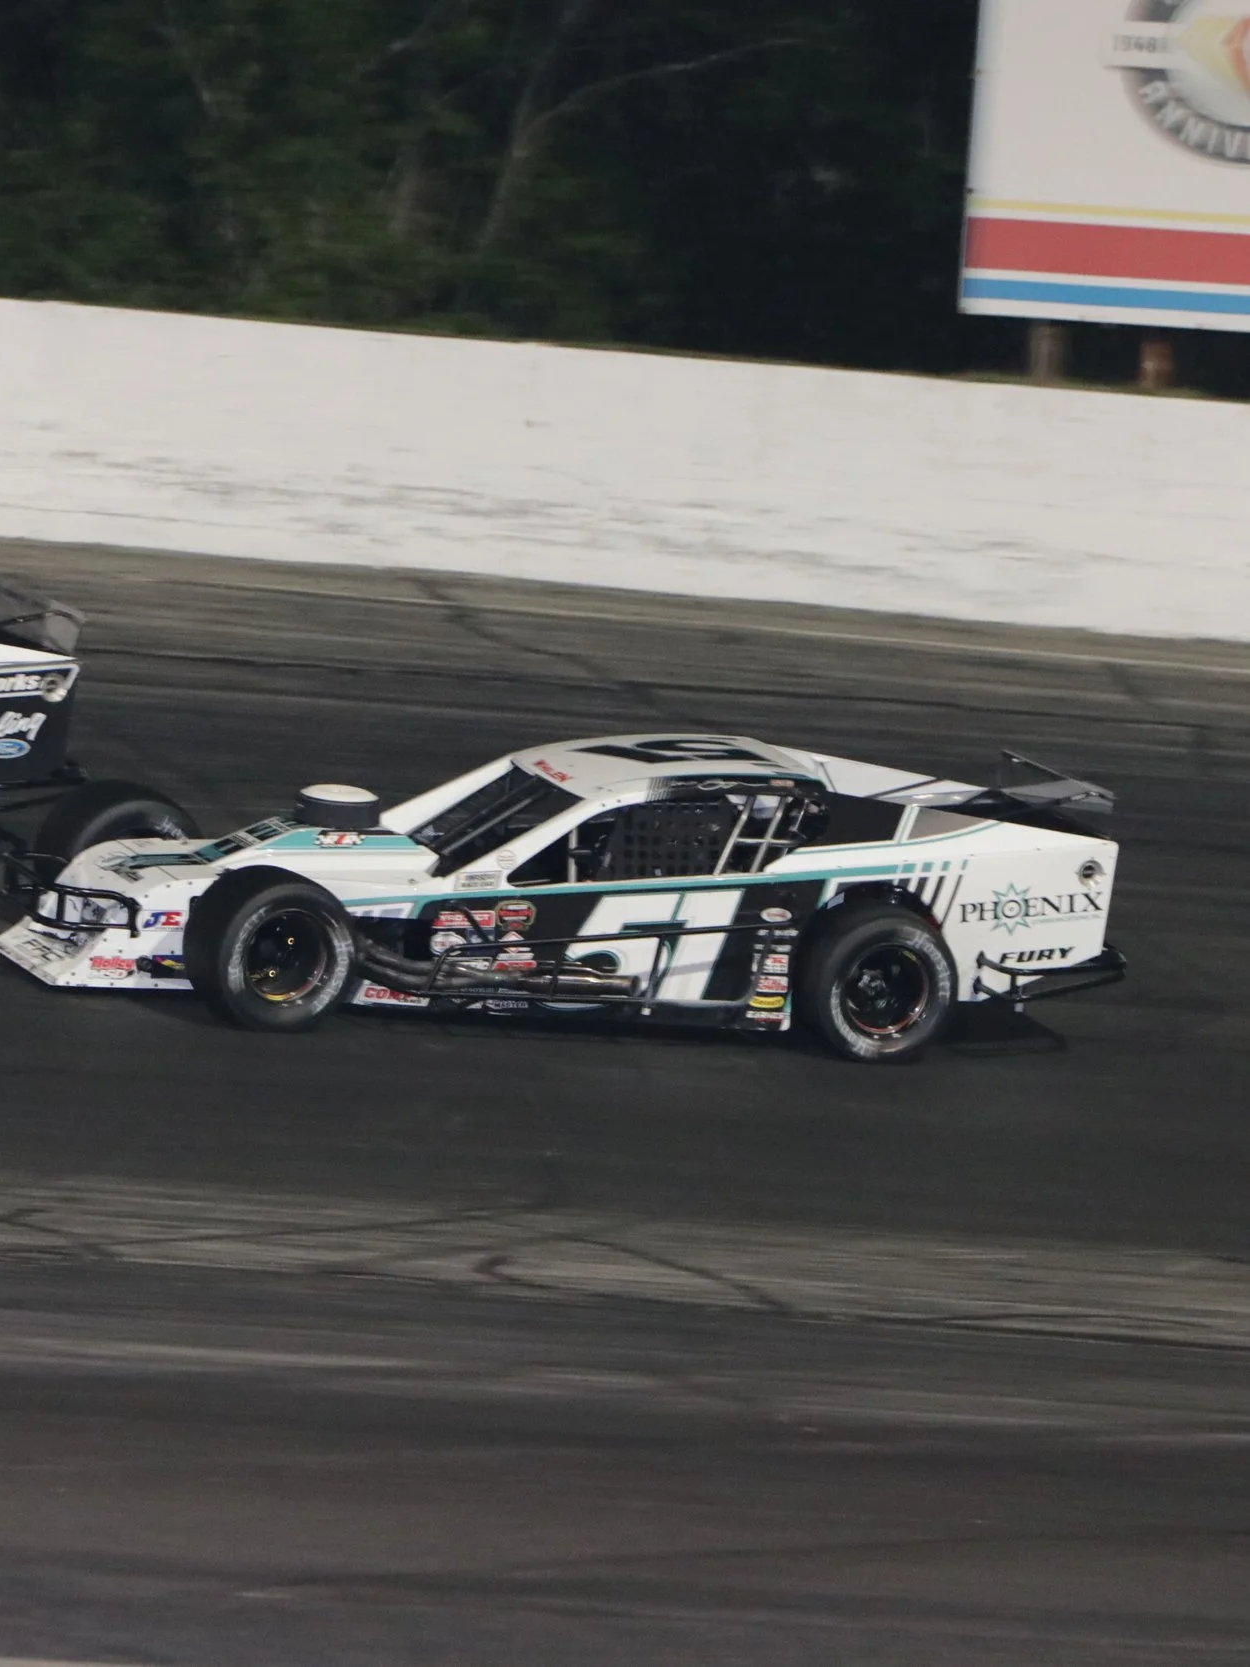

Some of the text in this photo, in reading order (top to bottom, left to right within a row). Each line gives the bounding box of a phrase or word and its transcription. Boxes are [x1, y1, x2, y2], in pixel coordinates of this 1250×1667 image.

[1138, 80, 1250, 158] ANNIV
[142, 911, 182, 928] JE
[960, 891, 1104, 924] PHOENIX
[563, 888, 745, 1001] 51
[1000, 946, 1075, 965] FURY
